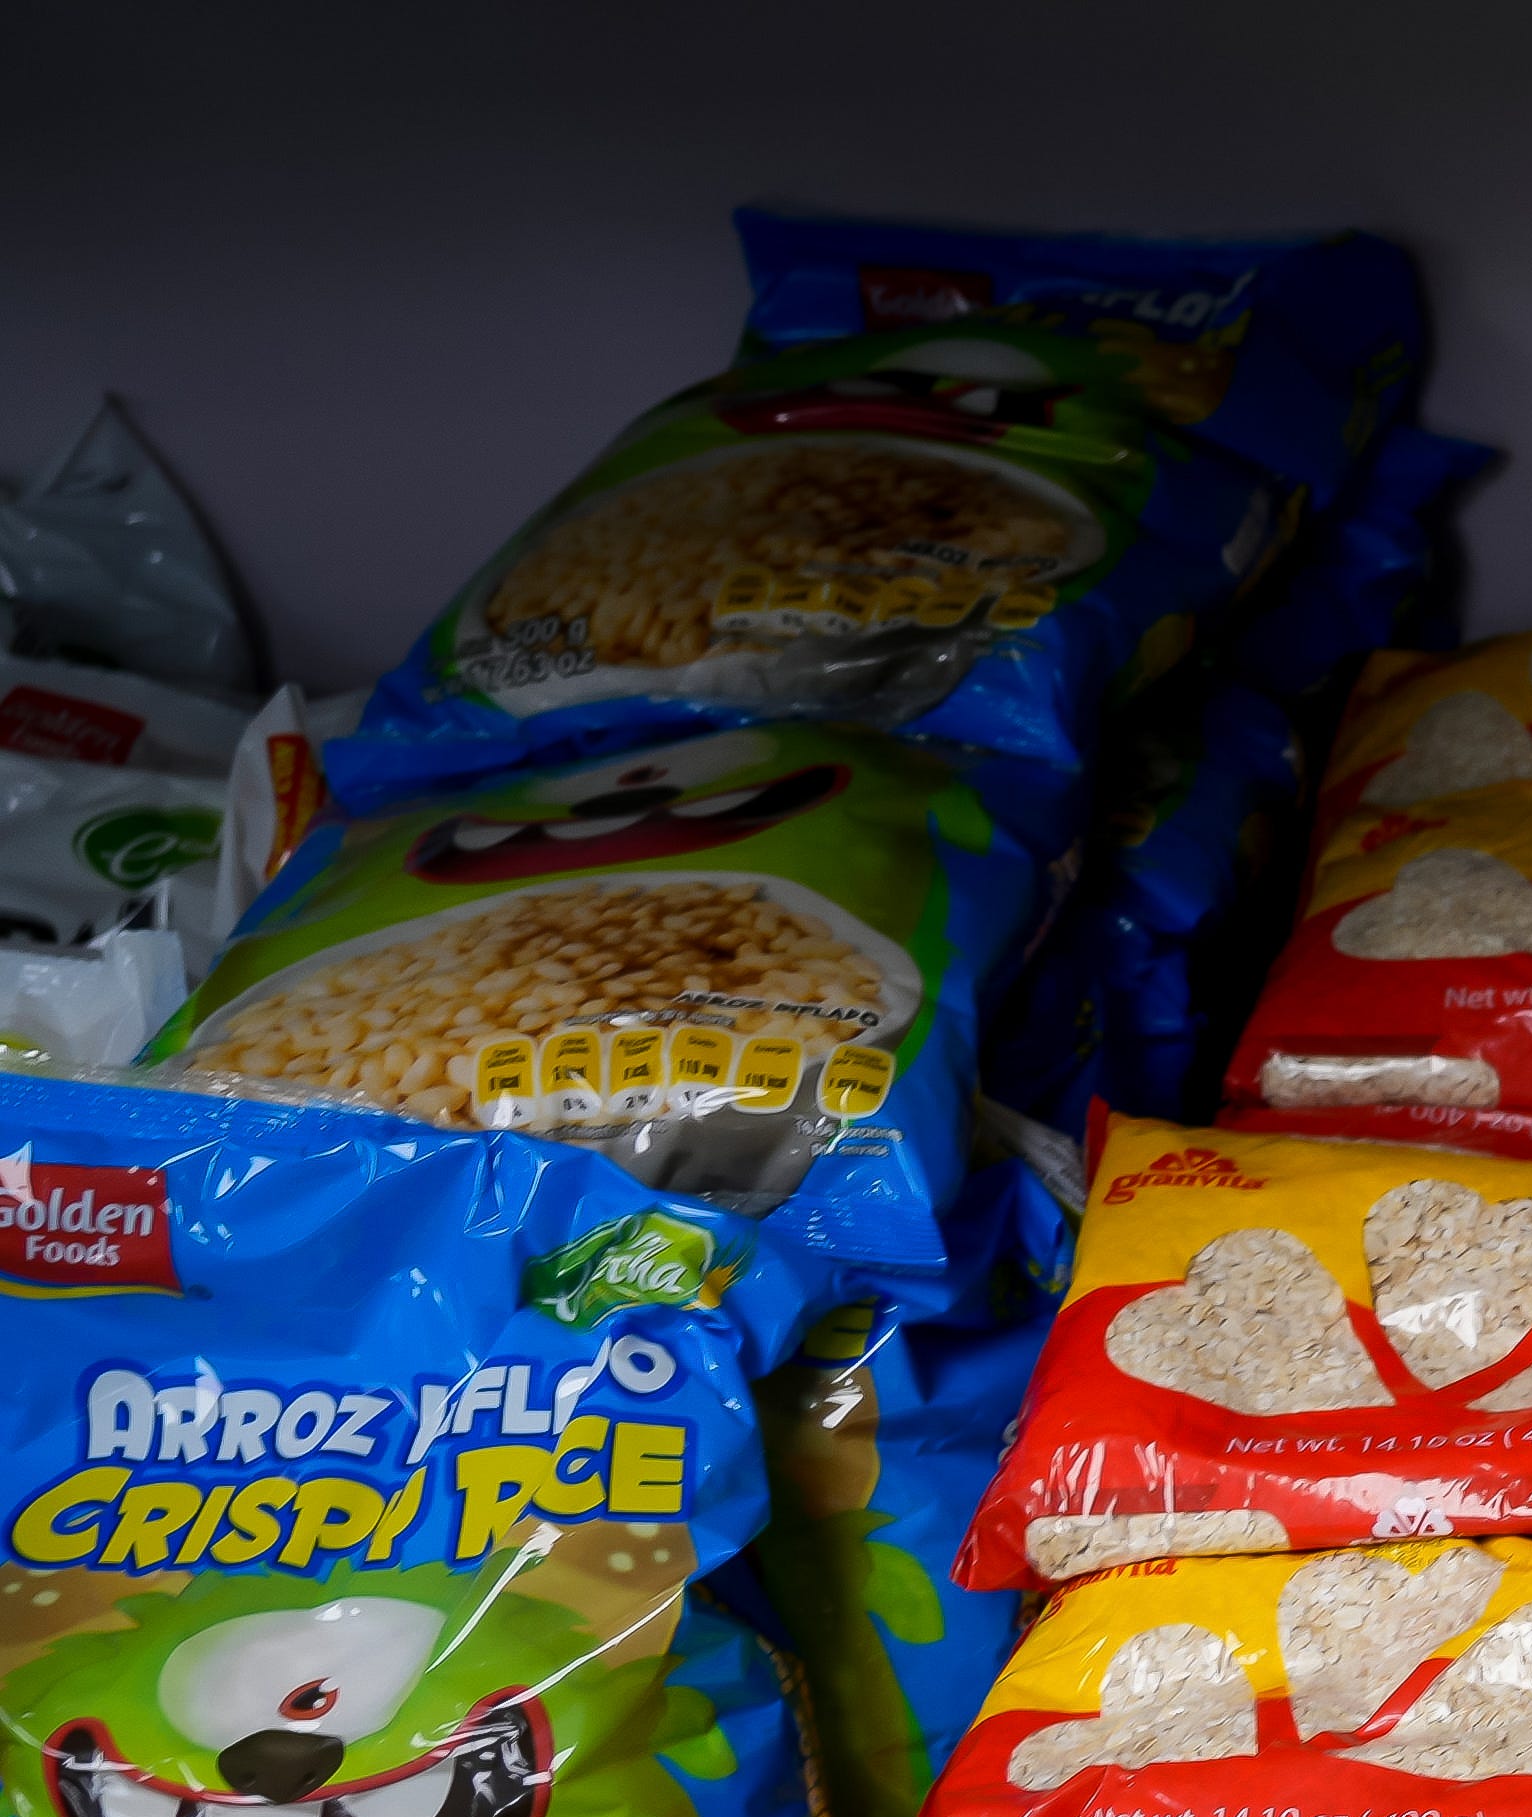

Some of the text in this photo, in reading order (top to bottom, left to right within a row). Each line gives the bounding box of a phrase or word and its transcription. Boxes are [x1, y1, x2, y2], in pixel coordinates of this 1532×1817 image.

[1445, 984, 1495, 1009] Net
[1102, 1171, 1269, 1206] granvita
[25, 1234, 121, 1267] Foods
[86, 1367, 395, 1465] ARROZ
[1224, 1434, 1289, 1455] Net
[1297, 1435, 1345, 1454] wt.
[1454, 1431, 1494, 1450] oz
[456, 1415, 687, 1562] RCE
